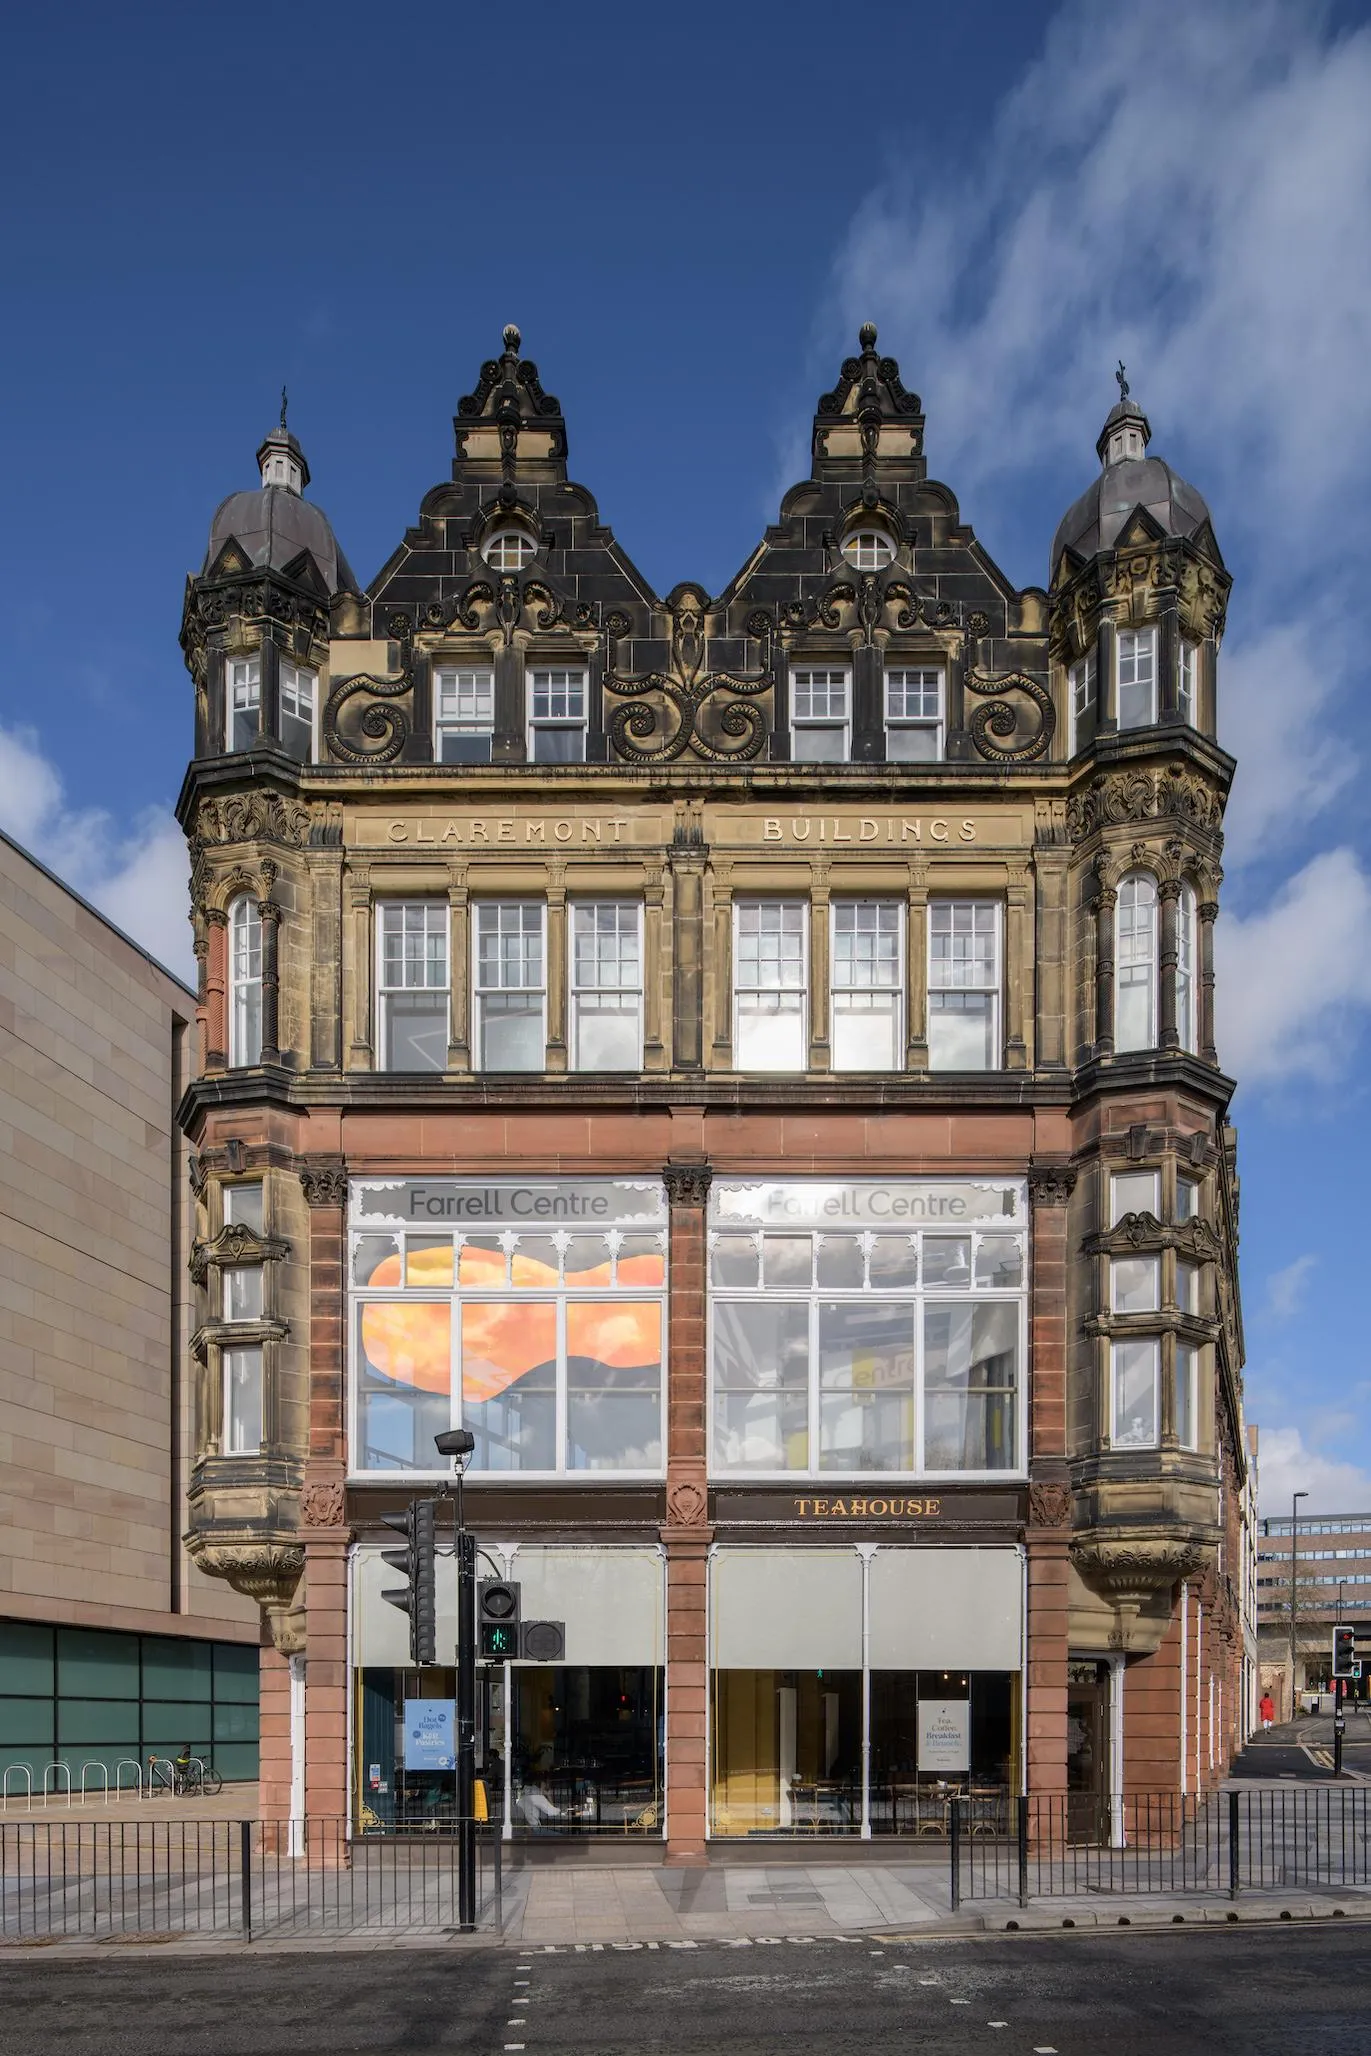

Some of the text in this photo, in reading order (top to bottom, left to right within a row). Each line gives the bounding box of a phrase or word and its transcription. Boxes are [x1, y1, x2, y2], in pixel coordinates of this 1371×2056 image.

[387, 819, 977, 842] CLAREMONT BUILDINGS
[410, 1189, 608, 1216] Farrell Centre
[767, 1189, 967, 1217] Faell Centre
[794, 1500, 940, 1516] TEAHOUSE
